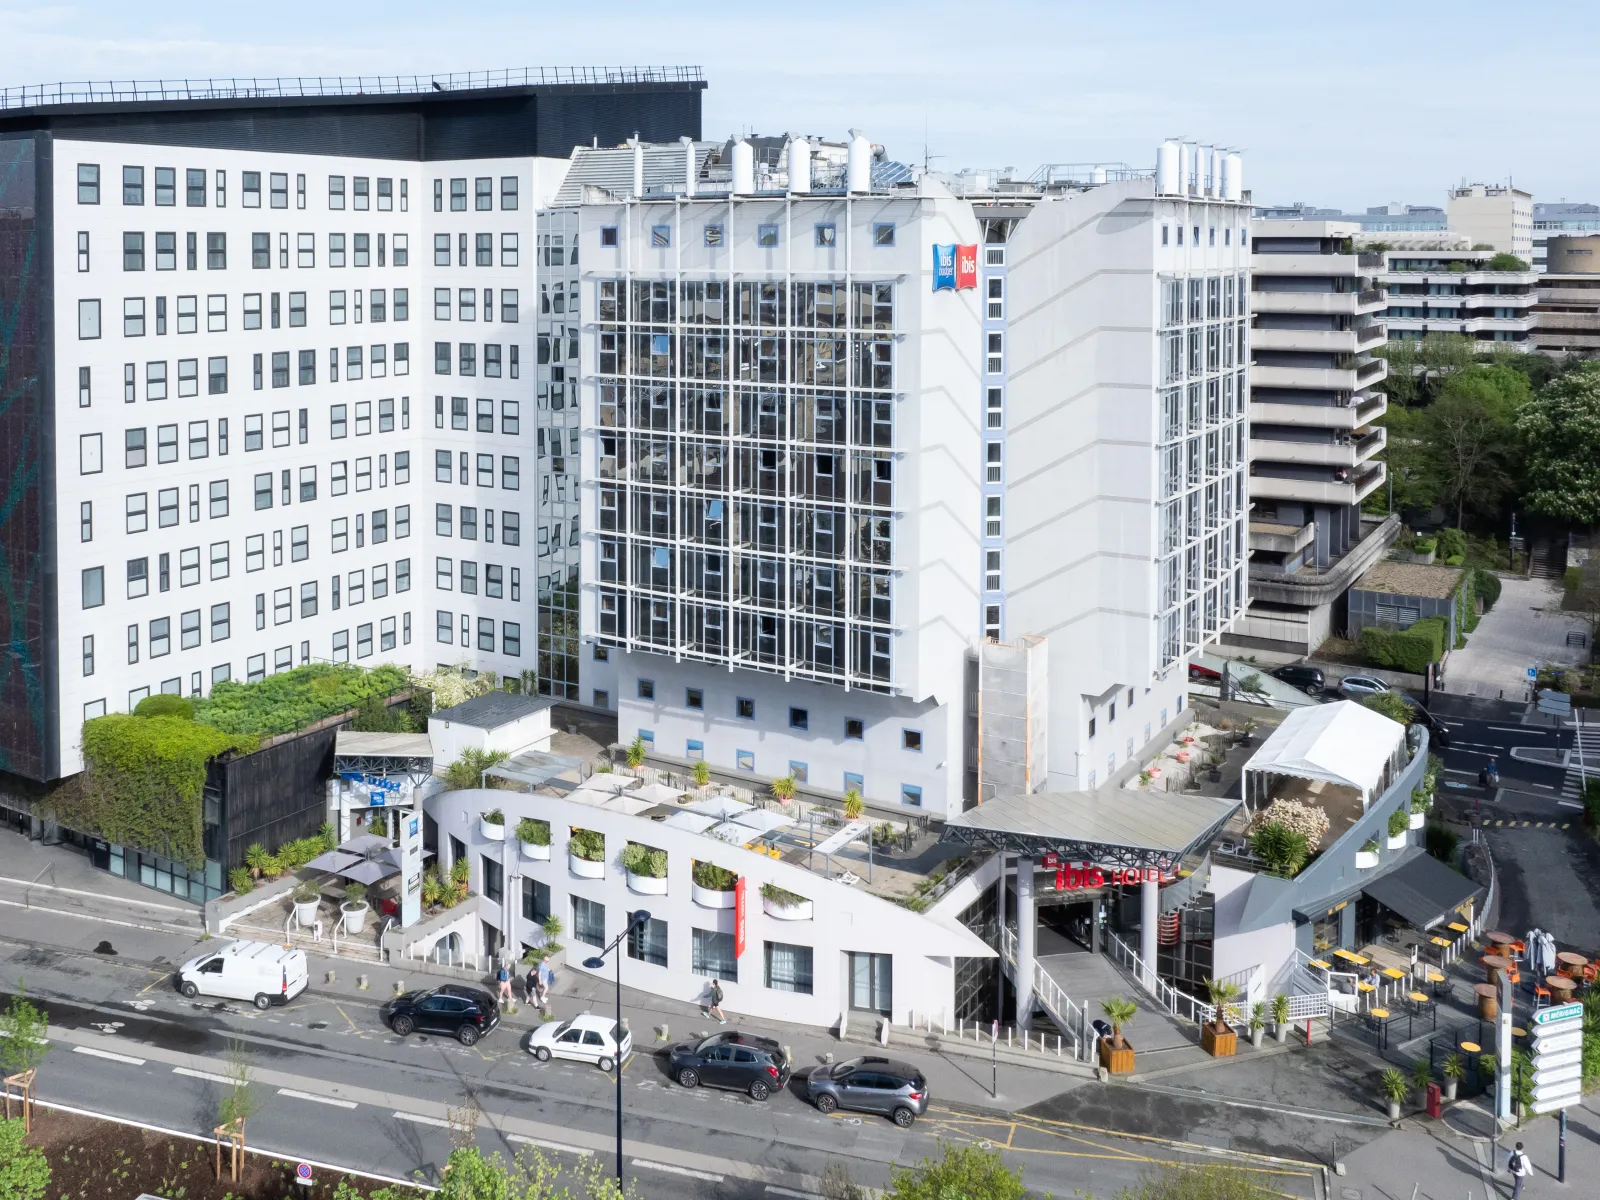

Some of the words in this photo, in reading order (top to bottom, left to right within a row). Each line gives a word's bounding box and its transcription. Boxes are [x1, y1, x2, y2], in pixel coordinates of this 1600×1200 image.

[940, 252, 952, 267] ibis
[961, 255, 975, 274] ibis
[1055, 862, 1105, 891] ibis
[1111, 866, 1168, 887] HOTEL
